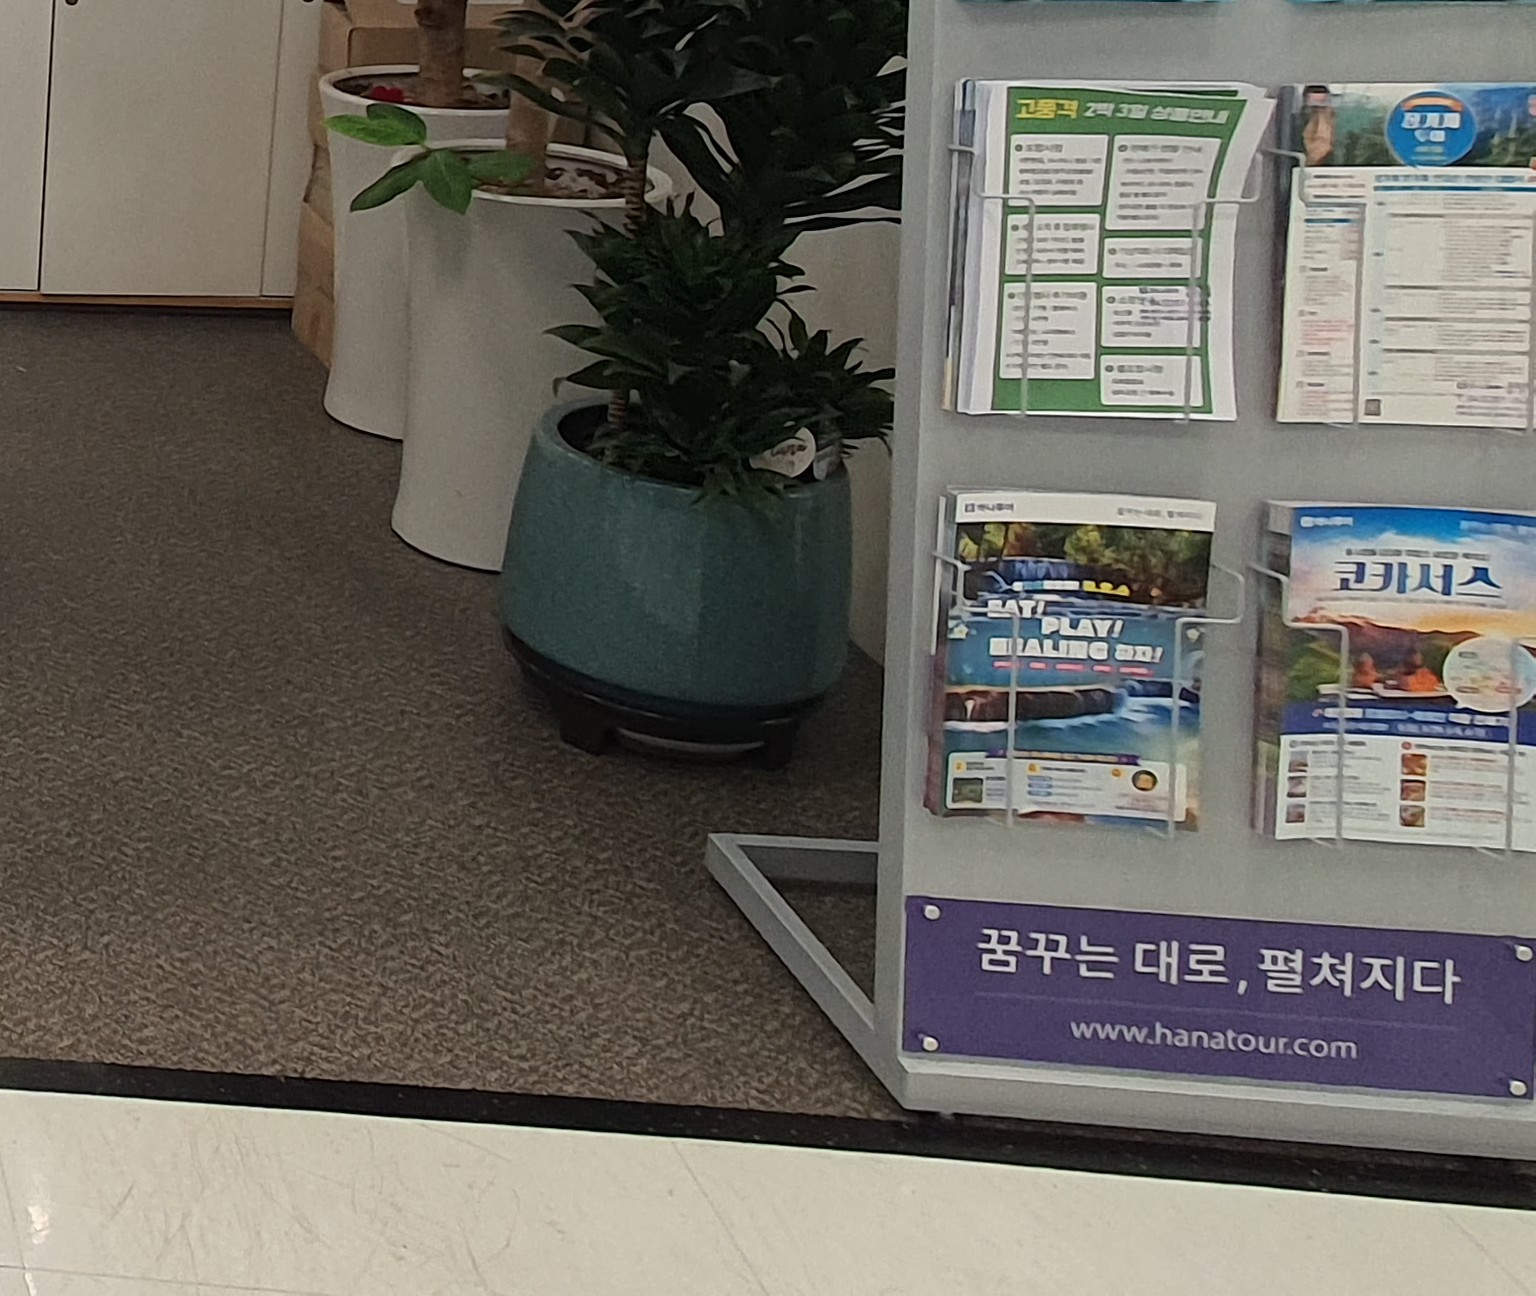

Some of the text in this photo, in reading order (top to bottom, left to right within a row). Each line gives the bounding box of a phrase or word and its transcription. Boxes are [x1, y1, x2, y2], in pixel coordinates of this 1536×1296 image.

[1332, 561, 1502, 599] 코카서스
[988, 600, 1045, 618] EAT!
[1041, 618, 1124, 638] PLAY!
[975, 927, 1462, 1005] 꿈꾸는 대로, 펼쳐지다
[1070, 1016, 1359, 1061] www.hanatour.com
